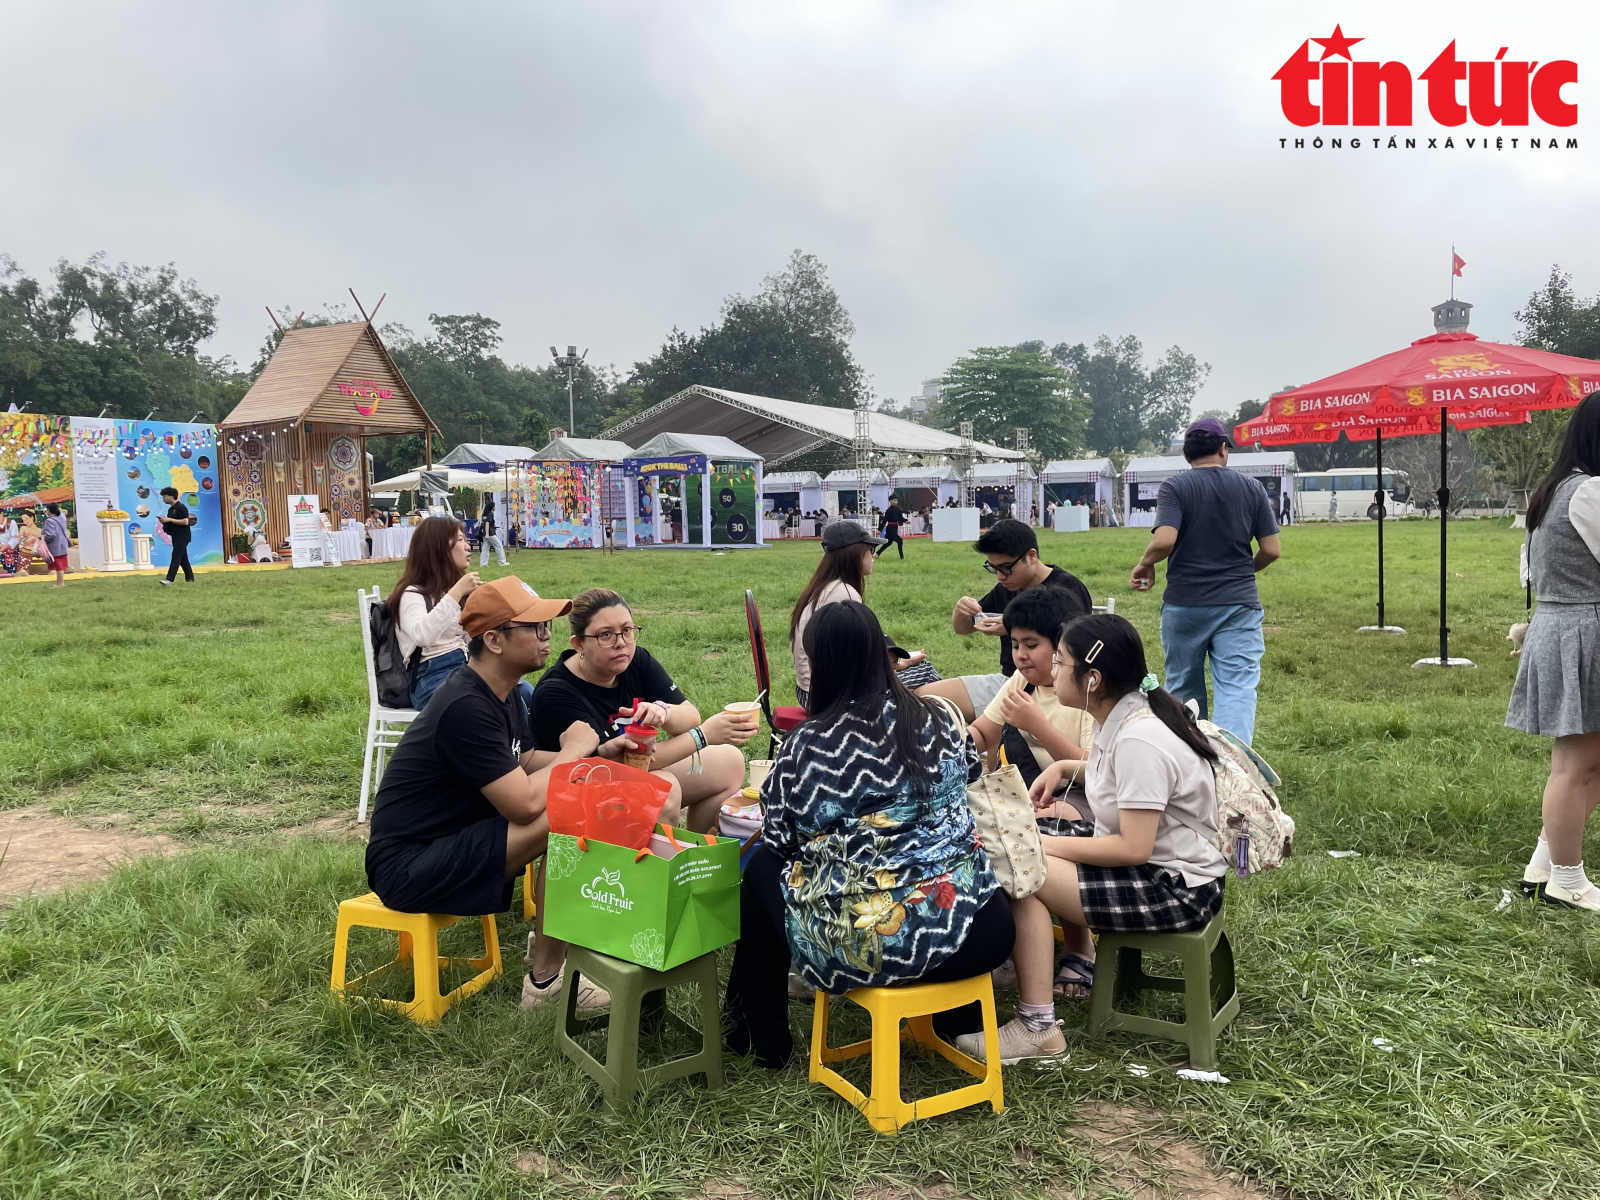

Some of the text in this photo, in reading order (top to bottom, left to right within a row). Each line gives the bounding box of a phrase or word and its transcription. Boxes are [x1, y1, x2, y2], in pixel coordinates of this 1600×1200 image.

[1425, 369, 1512, 380] SAIGON
[338, 384, 393, 399] THAILAND
[1432, 383, 1536, 402] BIA SAIGON
[1300, 391, 1371, 412] BIA SAIGON
[1251, 426, 1264, 437] BIA
[722, 495, 732, 503] 50
[731, 523, 744, 532] 30
[581, 883, 635, 911] Gold Fruit
